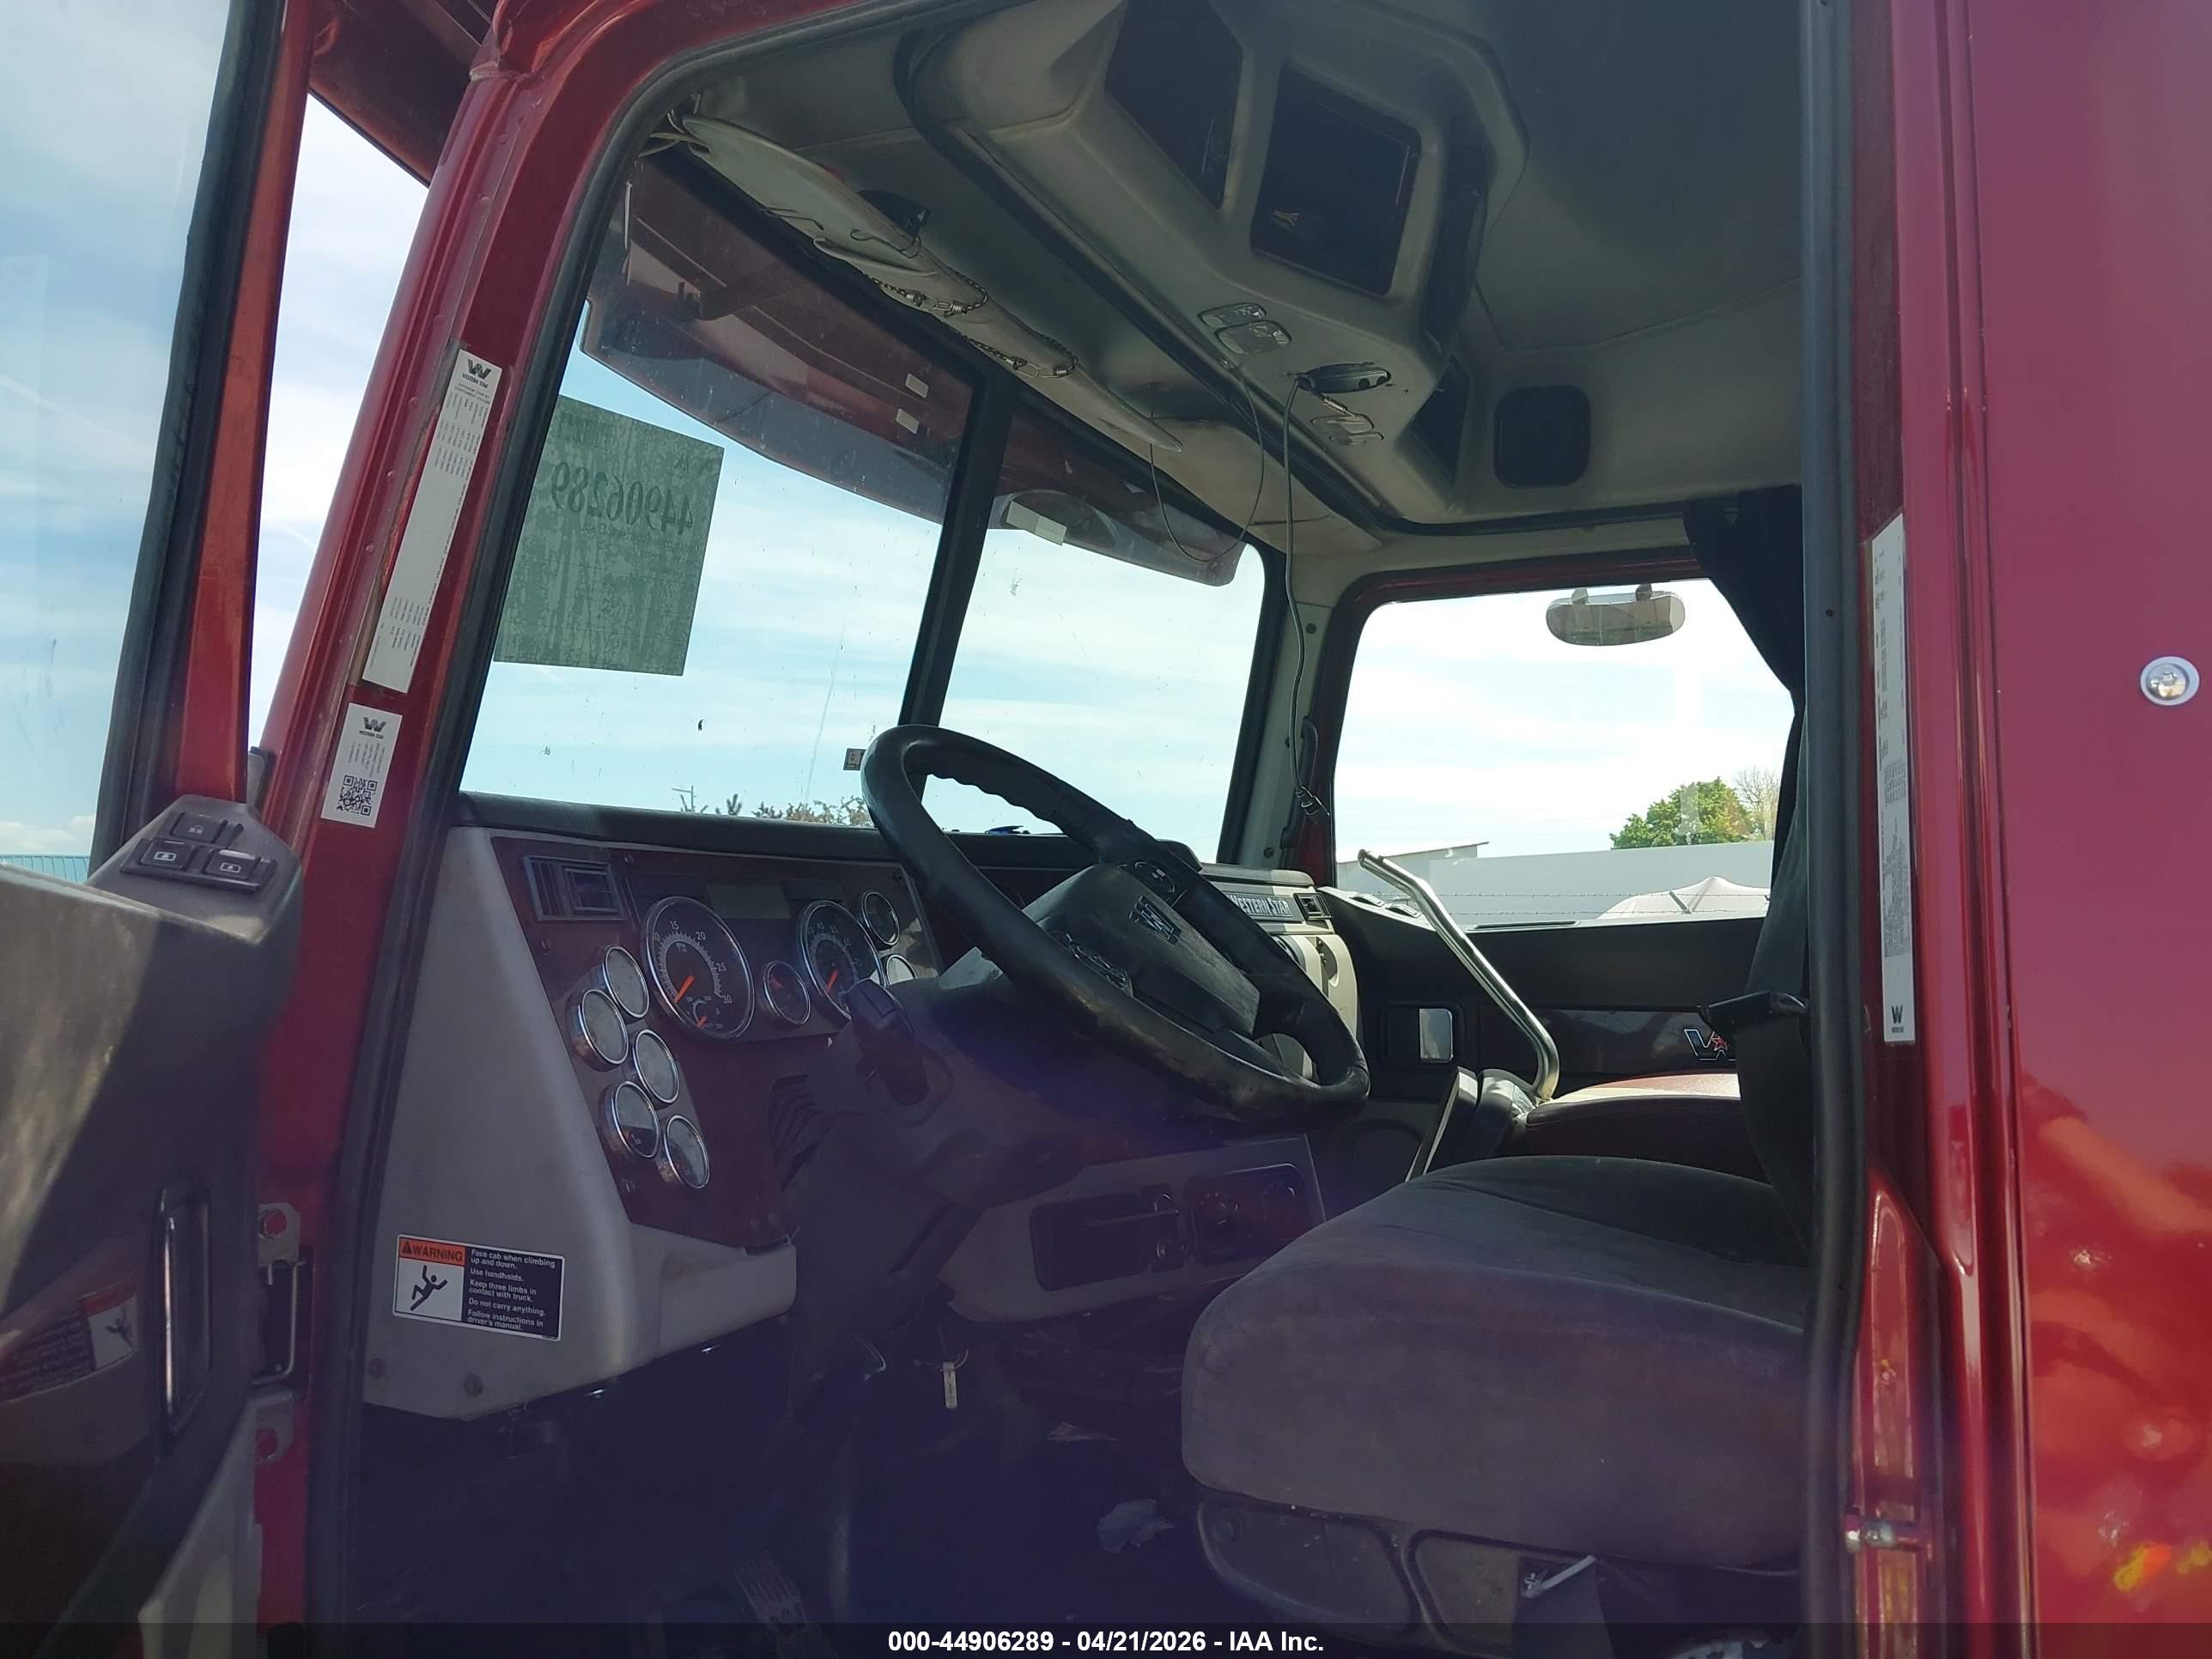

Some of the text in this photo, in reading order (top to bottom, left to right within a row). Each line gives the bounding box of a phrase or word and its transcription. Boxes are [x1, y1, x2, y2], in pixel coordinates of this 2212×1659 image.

[669, 921, 679, 931] 15
[696, 931, 707, 941] 20
[715, 963, 726, 972] 25
[722, 994, 732, 1004] 30
[412, 1246, 463, 1262] WARNING
[471, 1249, 556, 1269] Face cab when climbing
[471, 1257, 518, 1270] up and down.
[470, 1267, 524, 1281] Use handholds.
[469, 1279, 488, 1290] Keep
[489, 1282, 507, 1291] three
[508, 1284, 528, 1294] limbs
[469, 1287, 533, 1303] contact with truck.
[469, 1297, 546, 1317] Do not carry anything.
[467, 1316, 523, 1331] driver's manual.
[468, 1309, 544, 1328] Follow instructions in
